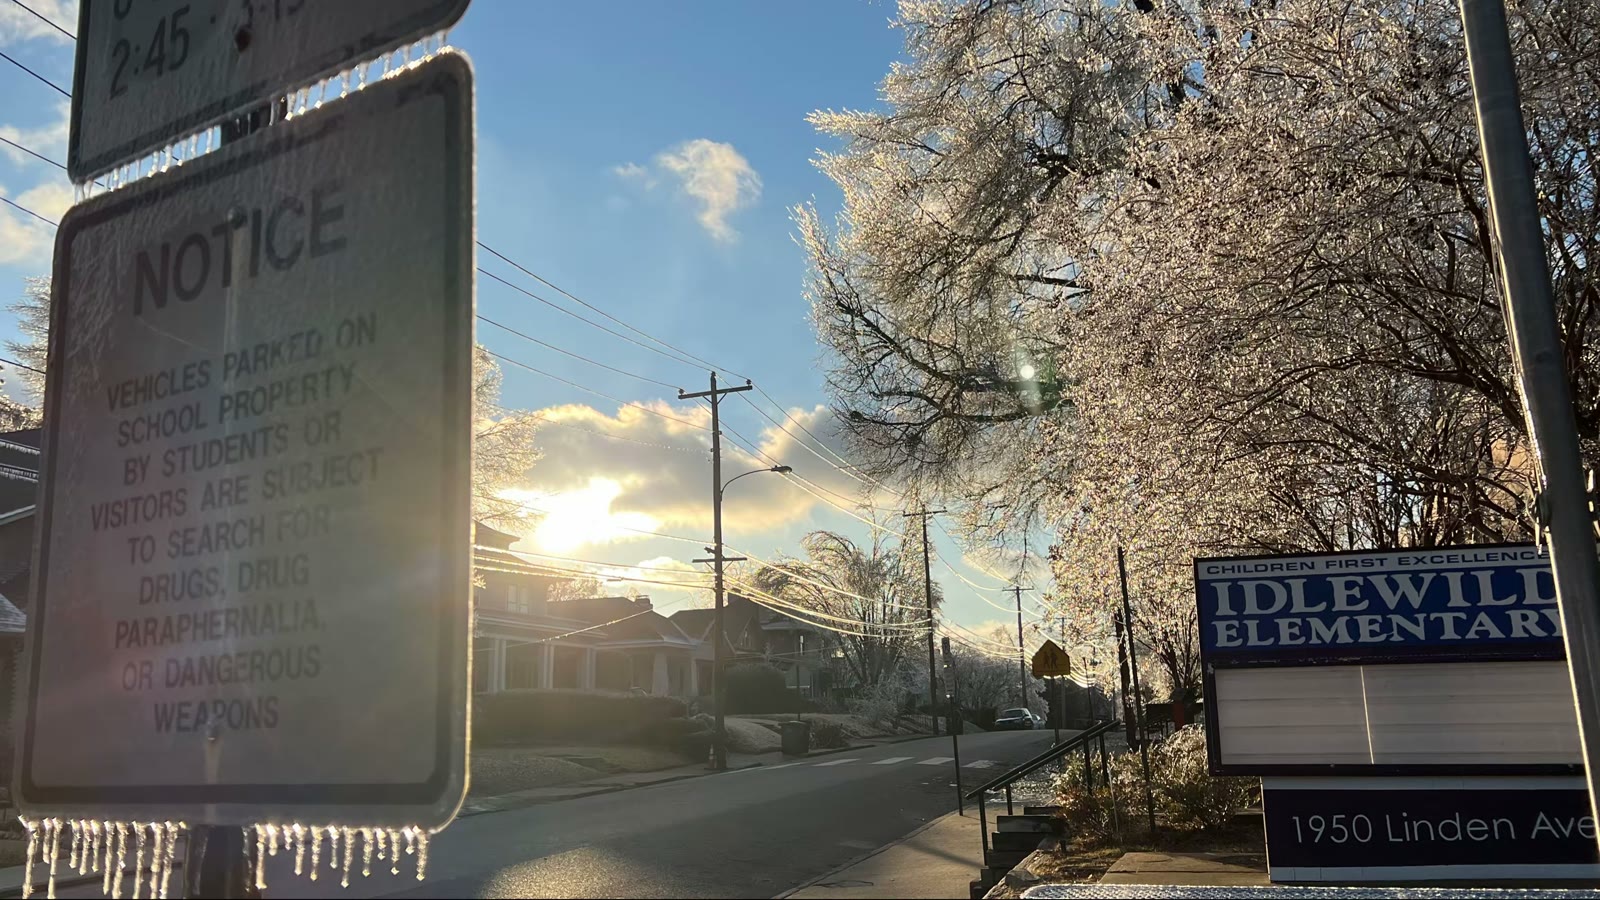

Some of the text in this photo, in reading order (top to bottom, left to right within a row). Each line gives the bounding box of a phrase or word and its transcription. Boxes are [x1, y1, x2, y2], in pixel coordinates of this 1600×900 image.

[110, 5, 190, 99] 2:45
[132, 187, 348, 316] NOTICE
[107, 312, 377, 412] VEHICLES PARKED ON
[117, 362, 356, 448] SCHOOL PROPERTY
[123, 410, 342, 486] BY STUDENTS OR
[90, 447, 385, 532] VISITORS ARE SUBJECT
[128, 504, 331, 566] TO SEARCH FOR
[1207, 561, 1315, 575] CHILDREN
[1325, 557, 1388, 570] FIRST
[139, 553, 310, 606] DRUGS, DRUG
[1211, 567, 1558, 616] IDLEWILD
[122, 645, 321, 691] OR DANGEROUS
[154, 696, 279, 734] WEAPONS
[1292, 811, 1597, 844] 1950 Linden Ave
